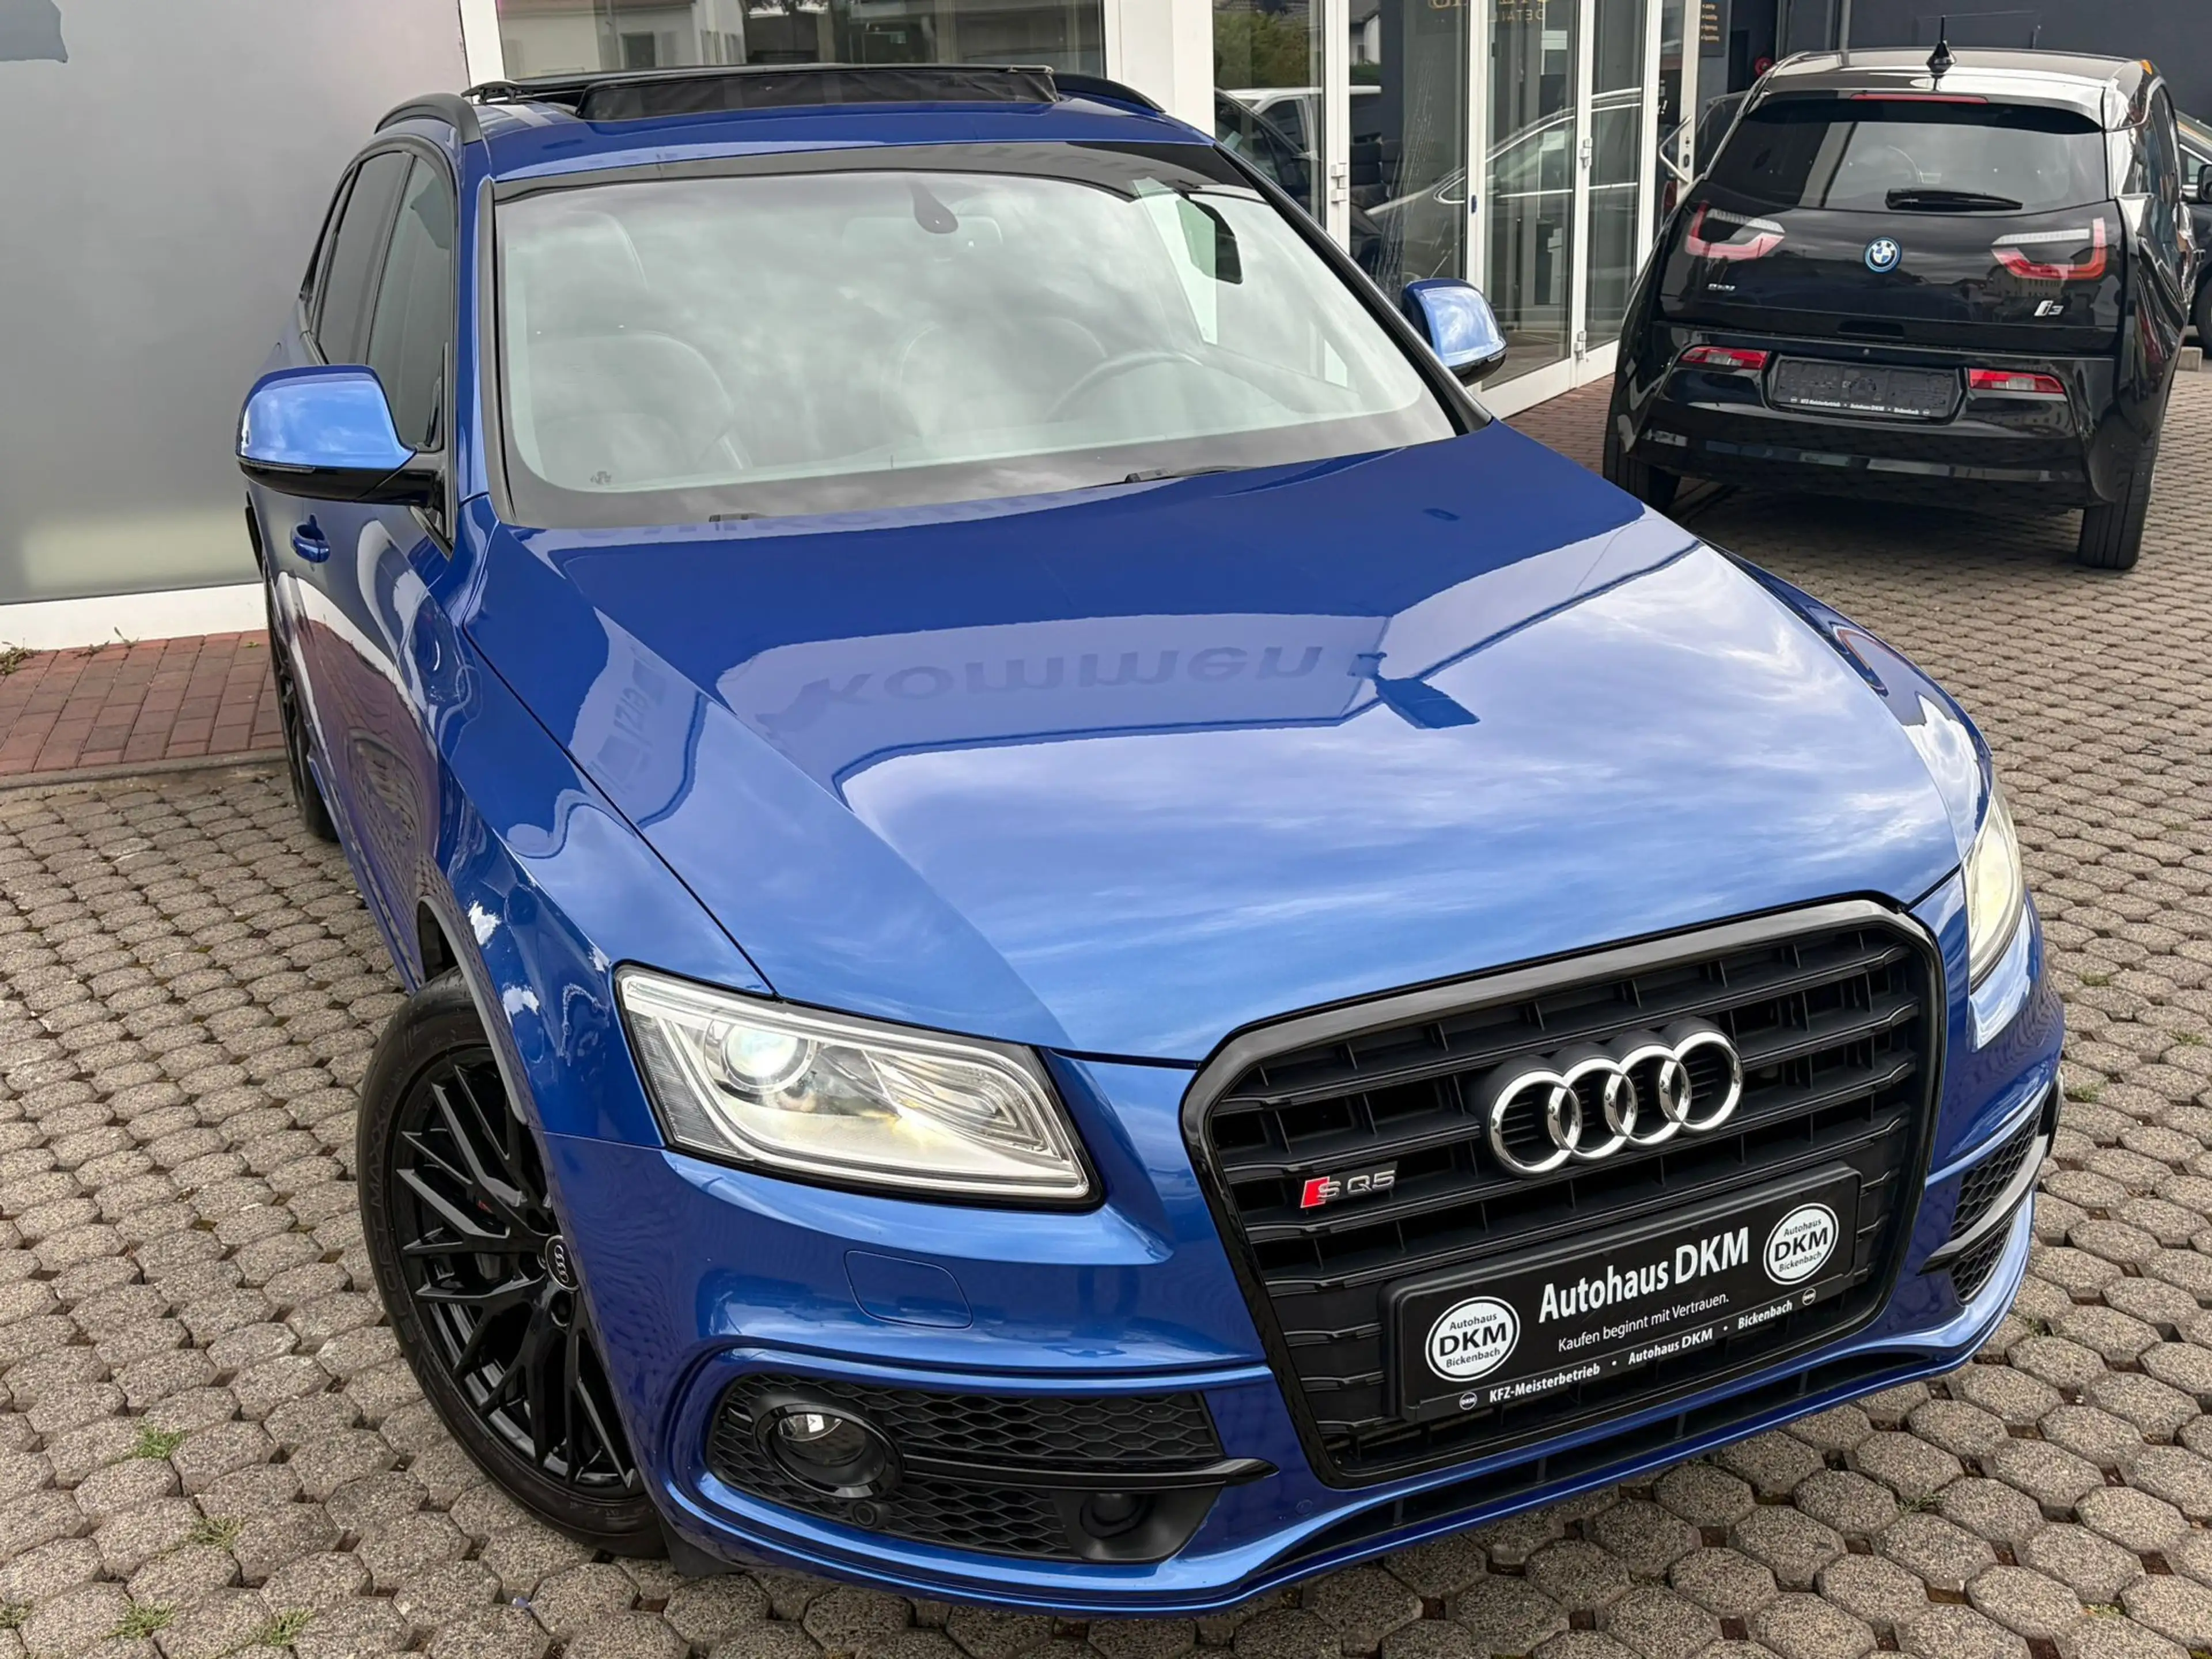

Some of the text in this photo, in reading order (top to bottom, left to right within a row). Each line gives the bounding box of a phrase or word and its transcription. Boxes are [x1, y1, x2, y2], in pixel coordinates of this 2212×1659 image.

[1774, 1227, 1828, 1262] DKM
[1783, 1218, 1822, 1237] Autohaus
[1537, 1226, 1749, 1324] Autohaus DKM
[1778, 1251, 1823, 1272] Bickenbach
[1439, 1322, 1508, 1357] DKM
[1449, 1313, 1498, 1331] Autohaus
[1558, 1292, 1730, 1353] Kaufen beginnt mit Vertrauen.
[1445, 1347, 1501, 1369] Bickenbach
[1488, 1300, 1793, 1404] KFZ-Meisterbetrieb Autohaus DKM Bickenbach
